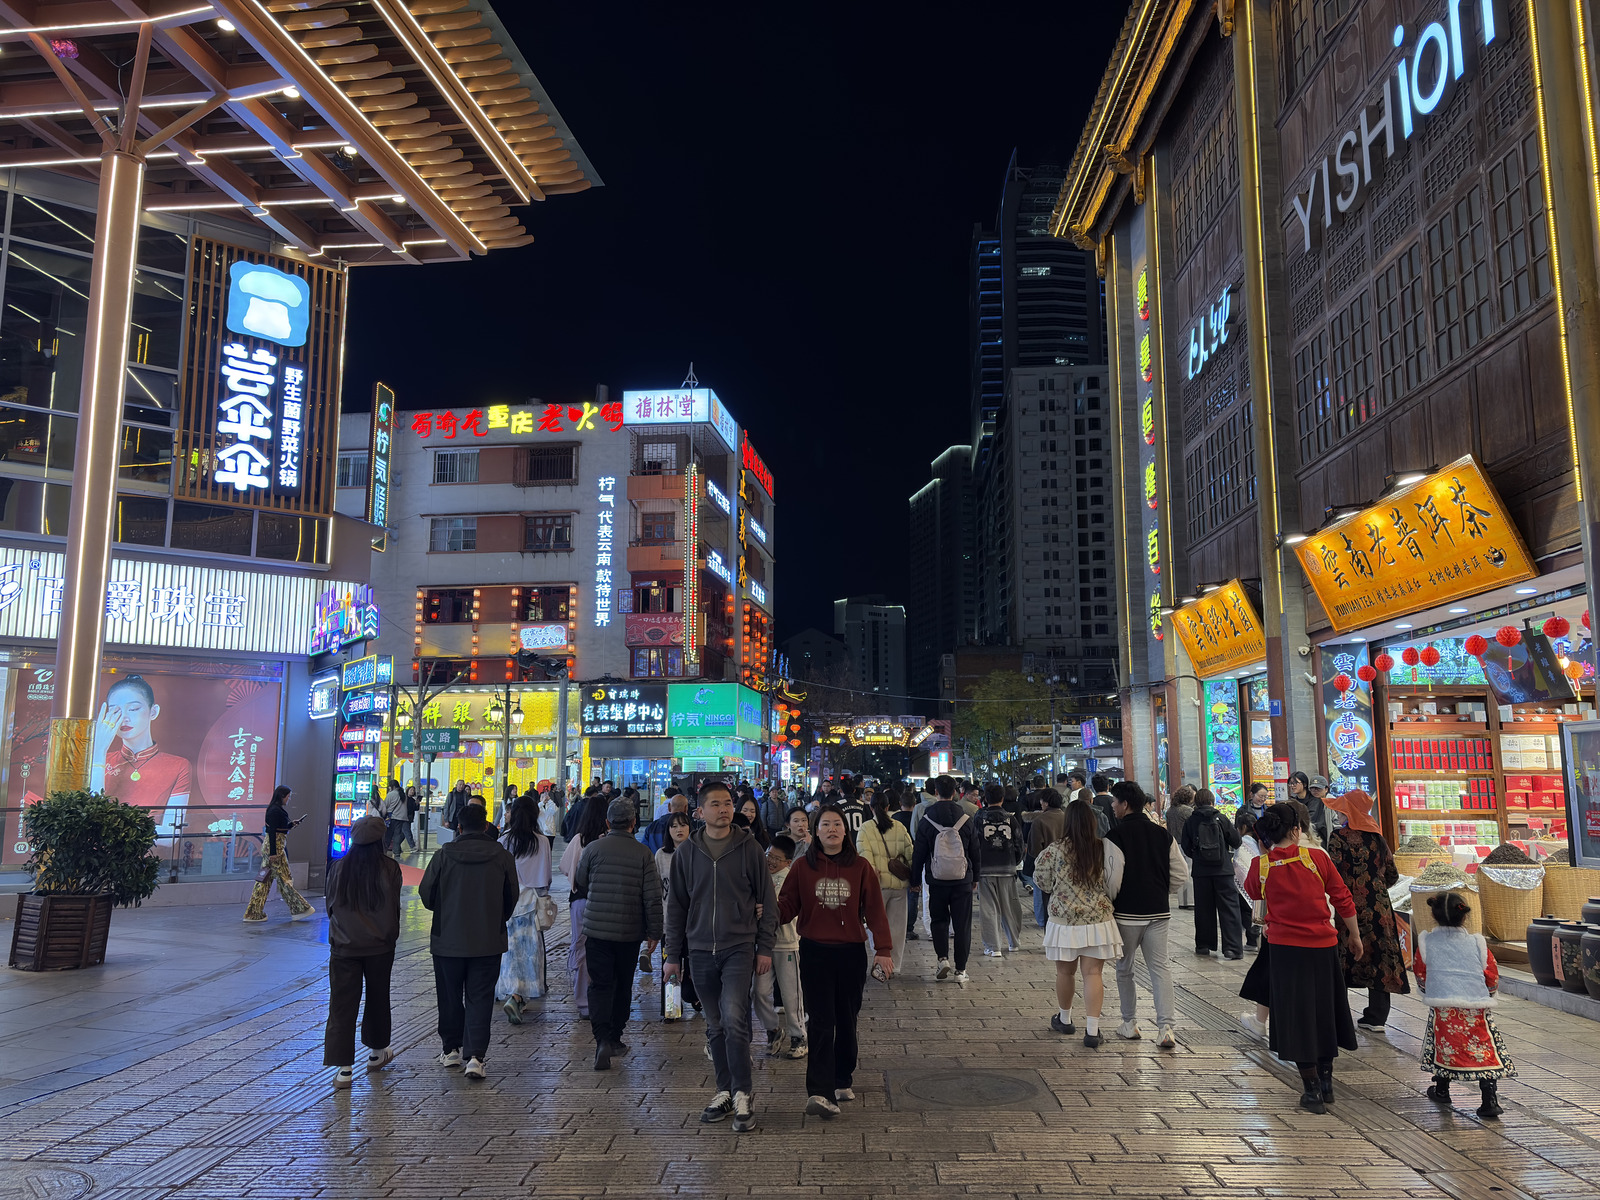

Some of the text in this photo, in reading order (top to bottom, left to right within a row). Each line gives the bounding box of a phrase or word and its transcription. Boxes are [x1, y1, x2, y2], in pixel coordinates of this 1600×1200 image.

[635, 394, 696, 419] 福林堂
[279, 367, 304, 487] 野生菌野菜火锅
[1319, 476, 1493, 590] 雲南老普洱茶
[1359, 594, 1375, 609] TEA
[583, 703, 664, 721] 名表维修中心
[704, 713, 735, 721] NINGQI
[855, 724, 902, 738] 公交记忆
[227, 727, 252, 783] 古法金
[515, 743, 558, 752] 经典新时
